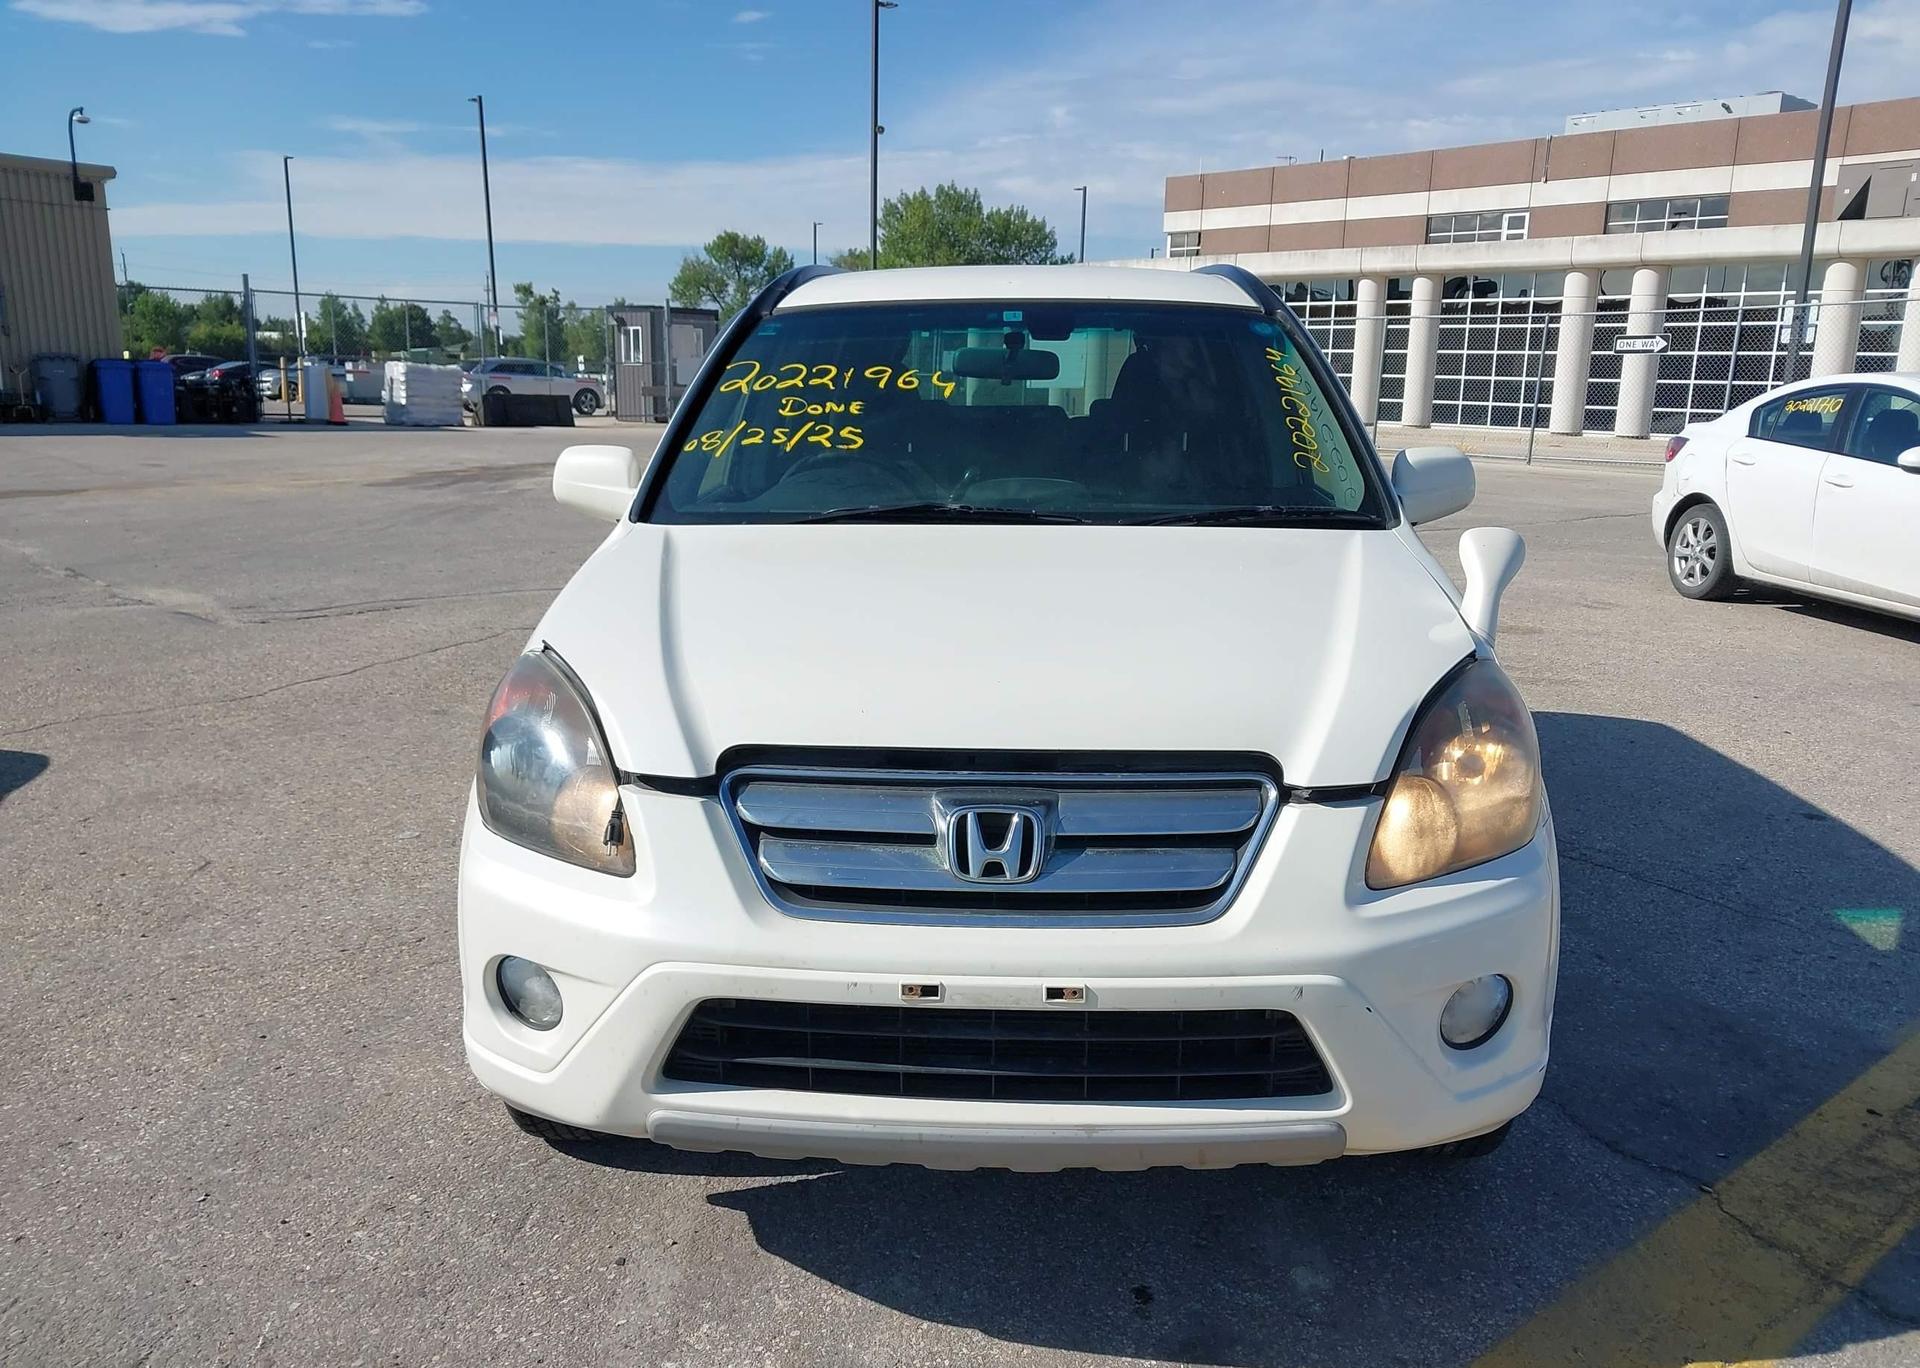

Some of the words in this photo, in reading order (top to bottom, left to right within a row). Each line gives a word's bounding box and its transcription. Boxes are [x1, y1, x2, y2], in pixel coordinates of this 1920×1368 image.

[1618, 340, 1637, 348] ONE
[1641, 340, 1661, 348] WAY
[719, 360, 956, 398] 20221964
[1265, 347, 1330, 473] 20221964
[683, 420, 864, 458] 08/25/25
